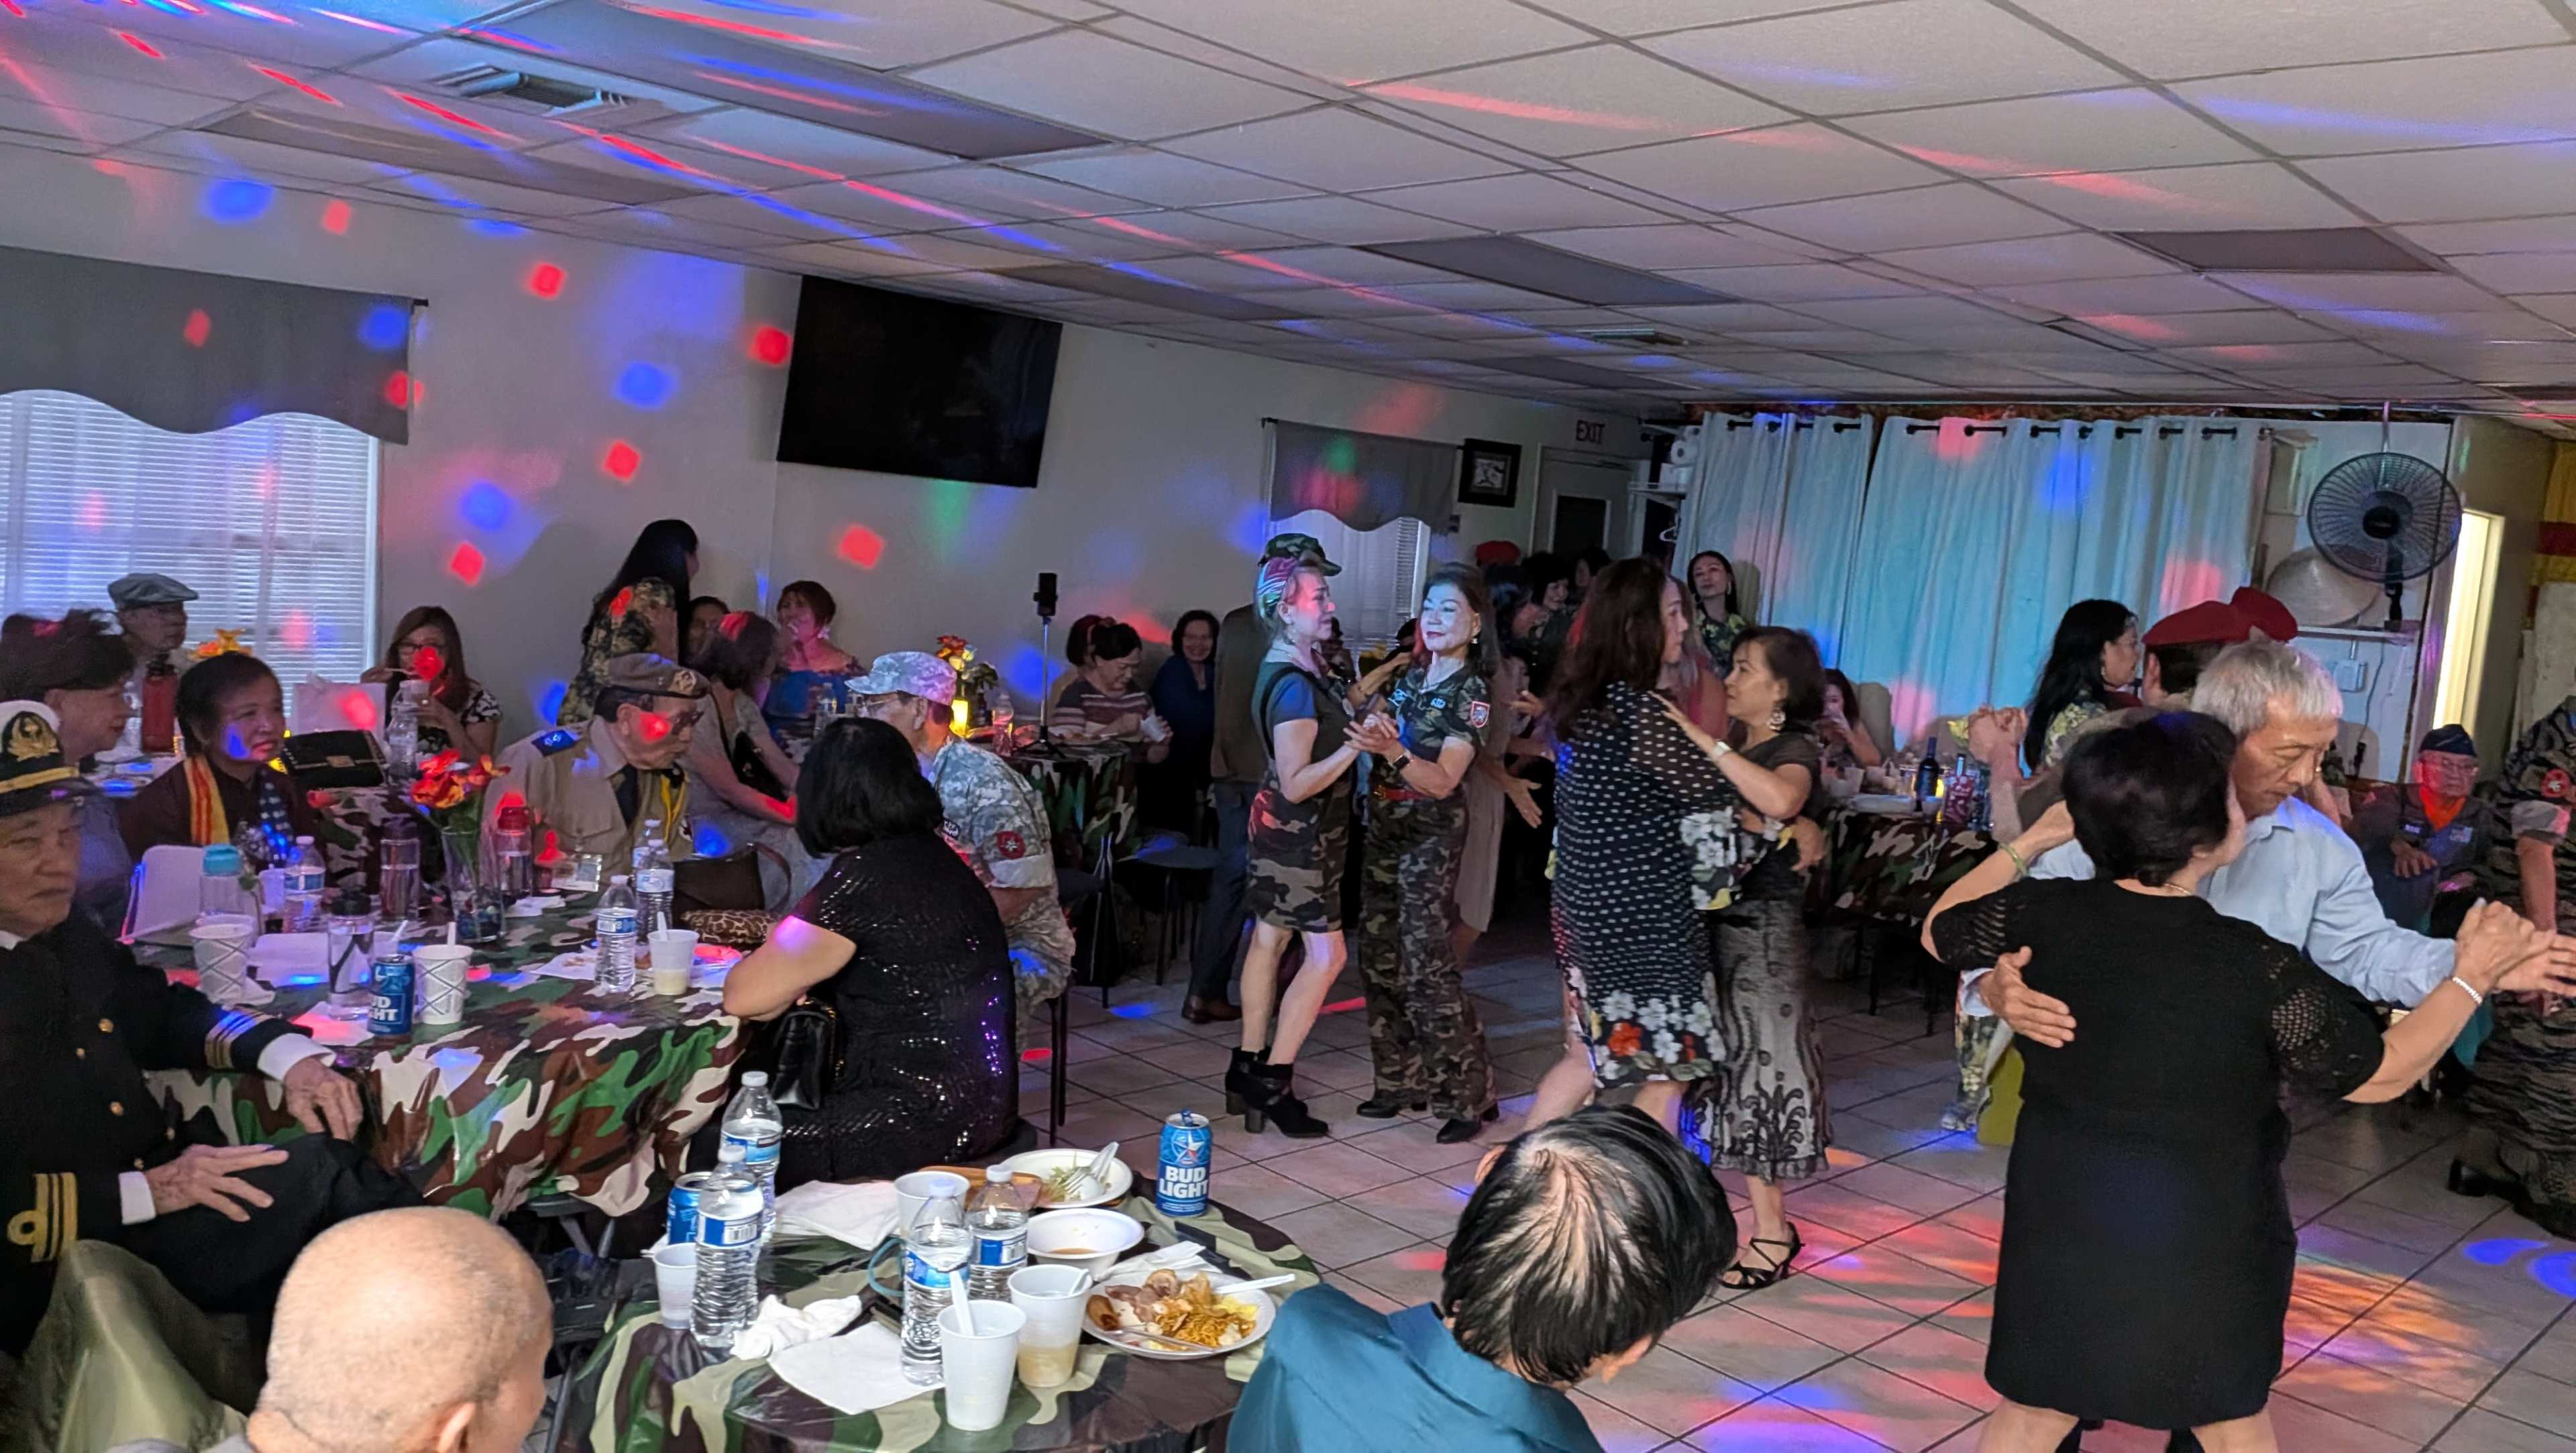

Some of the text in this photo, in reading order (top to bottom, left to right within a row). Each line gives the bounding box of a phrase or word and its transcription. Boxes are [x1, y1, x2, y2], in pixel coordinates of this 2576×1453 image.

[1576, 420, 1605, 444] EXIT
[1165, 1166, 1206, 1183] BUD
[1159, 1178, 1209, 1199] LIGHT
